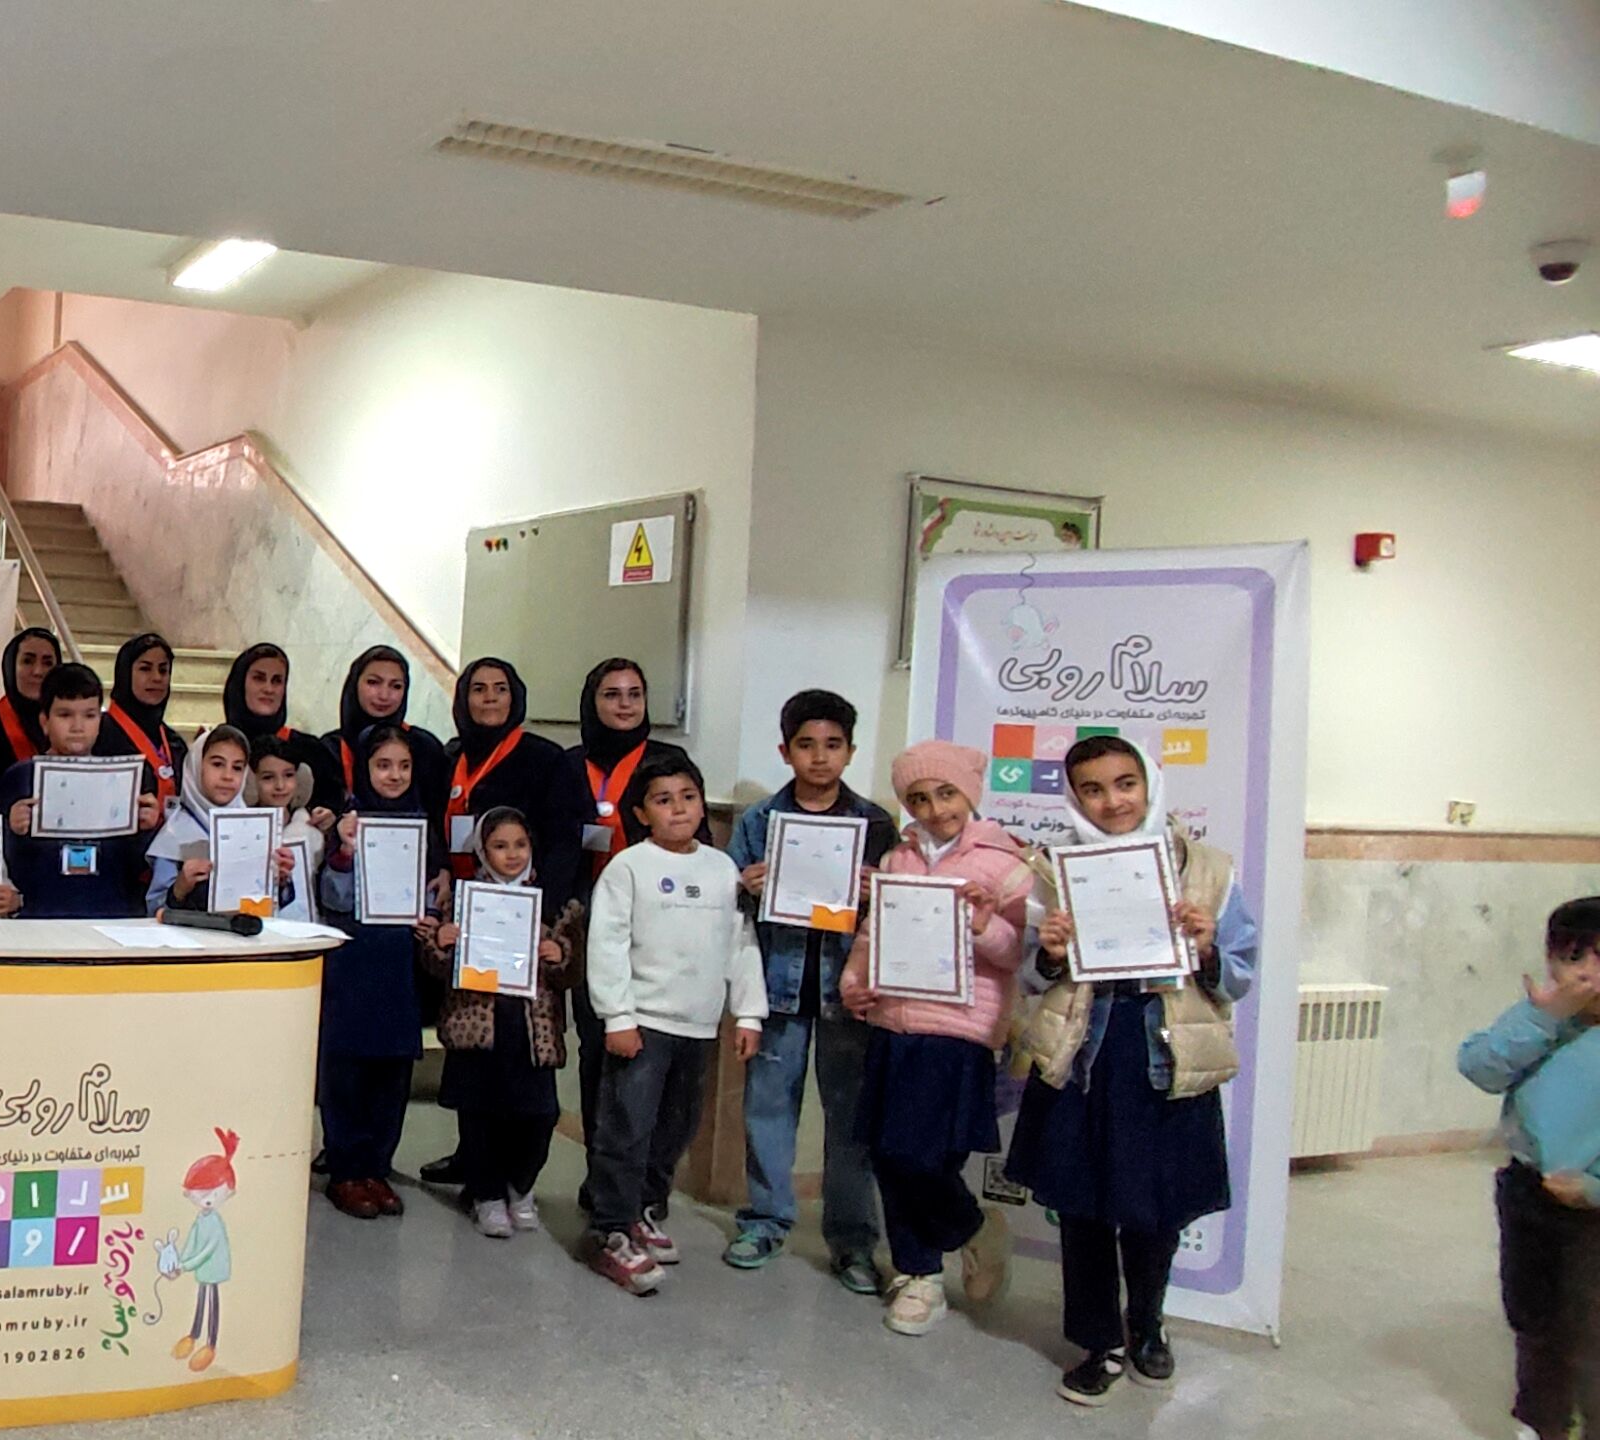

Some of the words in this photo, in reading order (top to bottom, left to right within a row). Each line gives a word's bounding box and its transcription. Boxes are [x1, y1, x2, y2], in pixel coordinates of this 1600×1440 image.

[999, 649, 1104, 701] روبی
[1111, 634, 1208, 703] سلام
[78, 1063, 150, 1134] سلام
[31, 1152, 42, 1164] در
[44, 1148, 91, 1164] متفاوت
